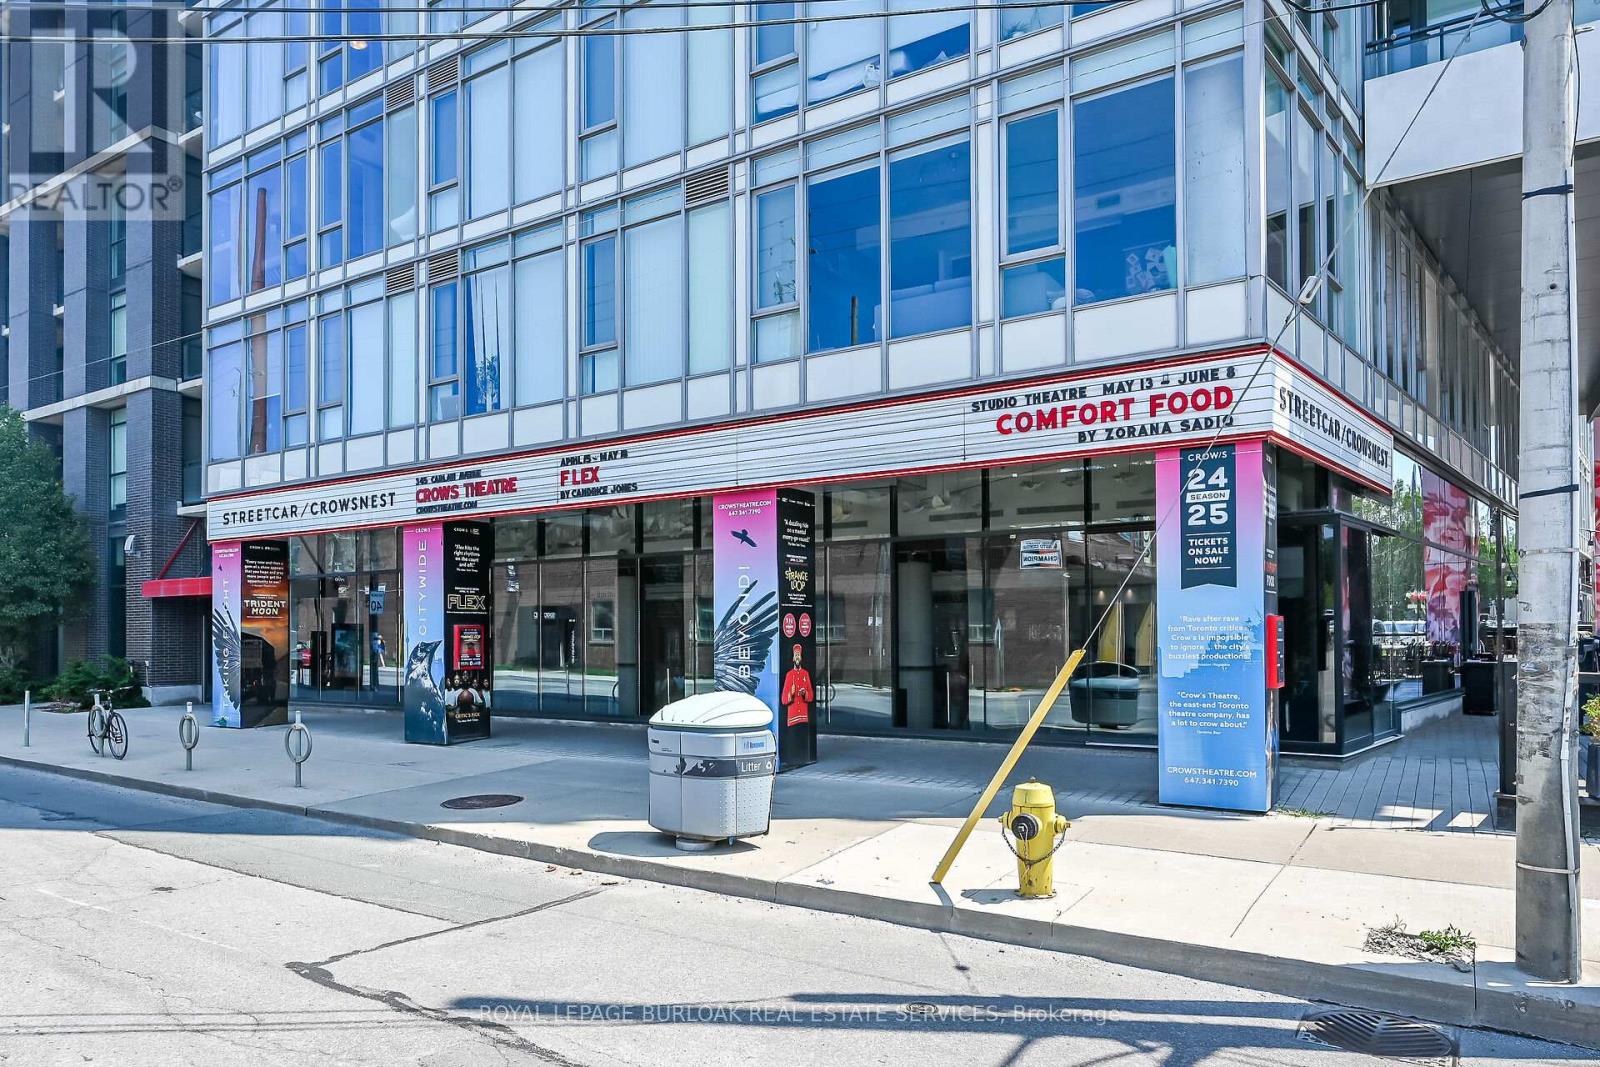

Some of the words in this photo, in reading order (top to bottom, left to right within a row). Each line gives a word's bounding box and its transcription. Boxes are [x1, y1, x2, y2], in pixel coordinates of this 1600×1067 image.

[971, 395, 1018, 413] STUDIO
[1025, 386, 1087, 404] THEATRE
[1103, 380, 1134, 396] MAY
[1140, 377, 1154, 391] 13
[1178, 369, 1220, 385] JUNE
[1227, 366, 1236, 378] 8
[996, 397, 1136, 435] COMFORT
[1149, 385, 1234, 418] FOOD
[1078, 430, 1097, 443] BY
[1105, 421, 1173, 441] ZORANA
[1279, 386, 1389, 469] STREETCAR/CROWSNEST
[599, 451, 619, 462] MAY
[1187, 466, 1228, 490] 24
[463, 477, 518, 498] THEATRE
[611, 483, 638, 494] JONES
[1190, 491, 1227, 501] SEASON
[222, 492, 396, 526] STREETCAR/CROWSNEST
[718, 500, 772, 510] CROWSTHEATRE.COM
[1187, 503, 1229, 526] 25
[1188, 537, 1229, 546] TICKETS
[1188, 548, 1204, 556] ON
[1205, 546, 1229, 555] SALE
[1194, 556, 1223, 565] NOW!
[785, 570, 809, 581] STRANGE
[418, 540, 427, 635] CITYWIDE
[790, 580, 806, 592] LOOP
[244, 599, 286, 608] TRIDENT
[447, 593, 486, 610] FLEX
[251, 607, 279, 615] MOON
[1188, 624, 1218, 632] Toronto
[1206, 633, 1249, 642] impossible
[1208, 692, 1241, 700] Theatre,
[1197, 711, 1235, 719] company,
[741, 761, 762, 773] Litter
[1167, 766, 1257, 778] CROWSTHEATRE.COM
[1184, 777, 1239, 786] 647.341.7390
